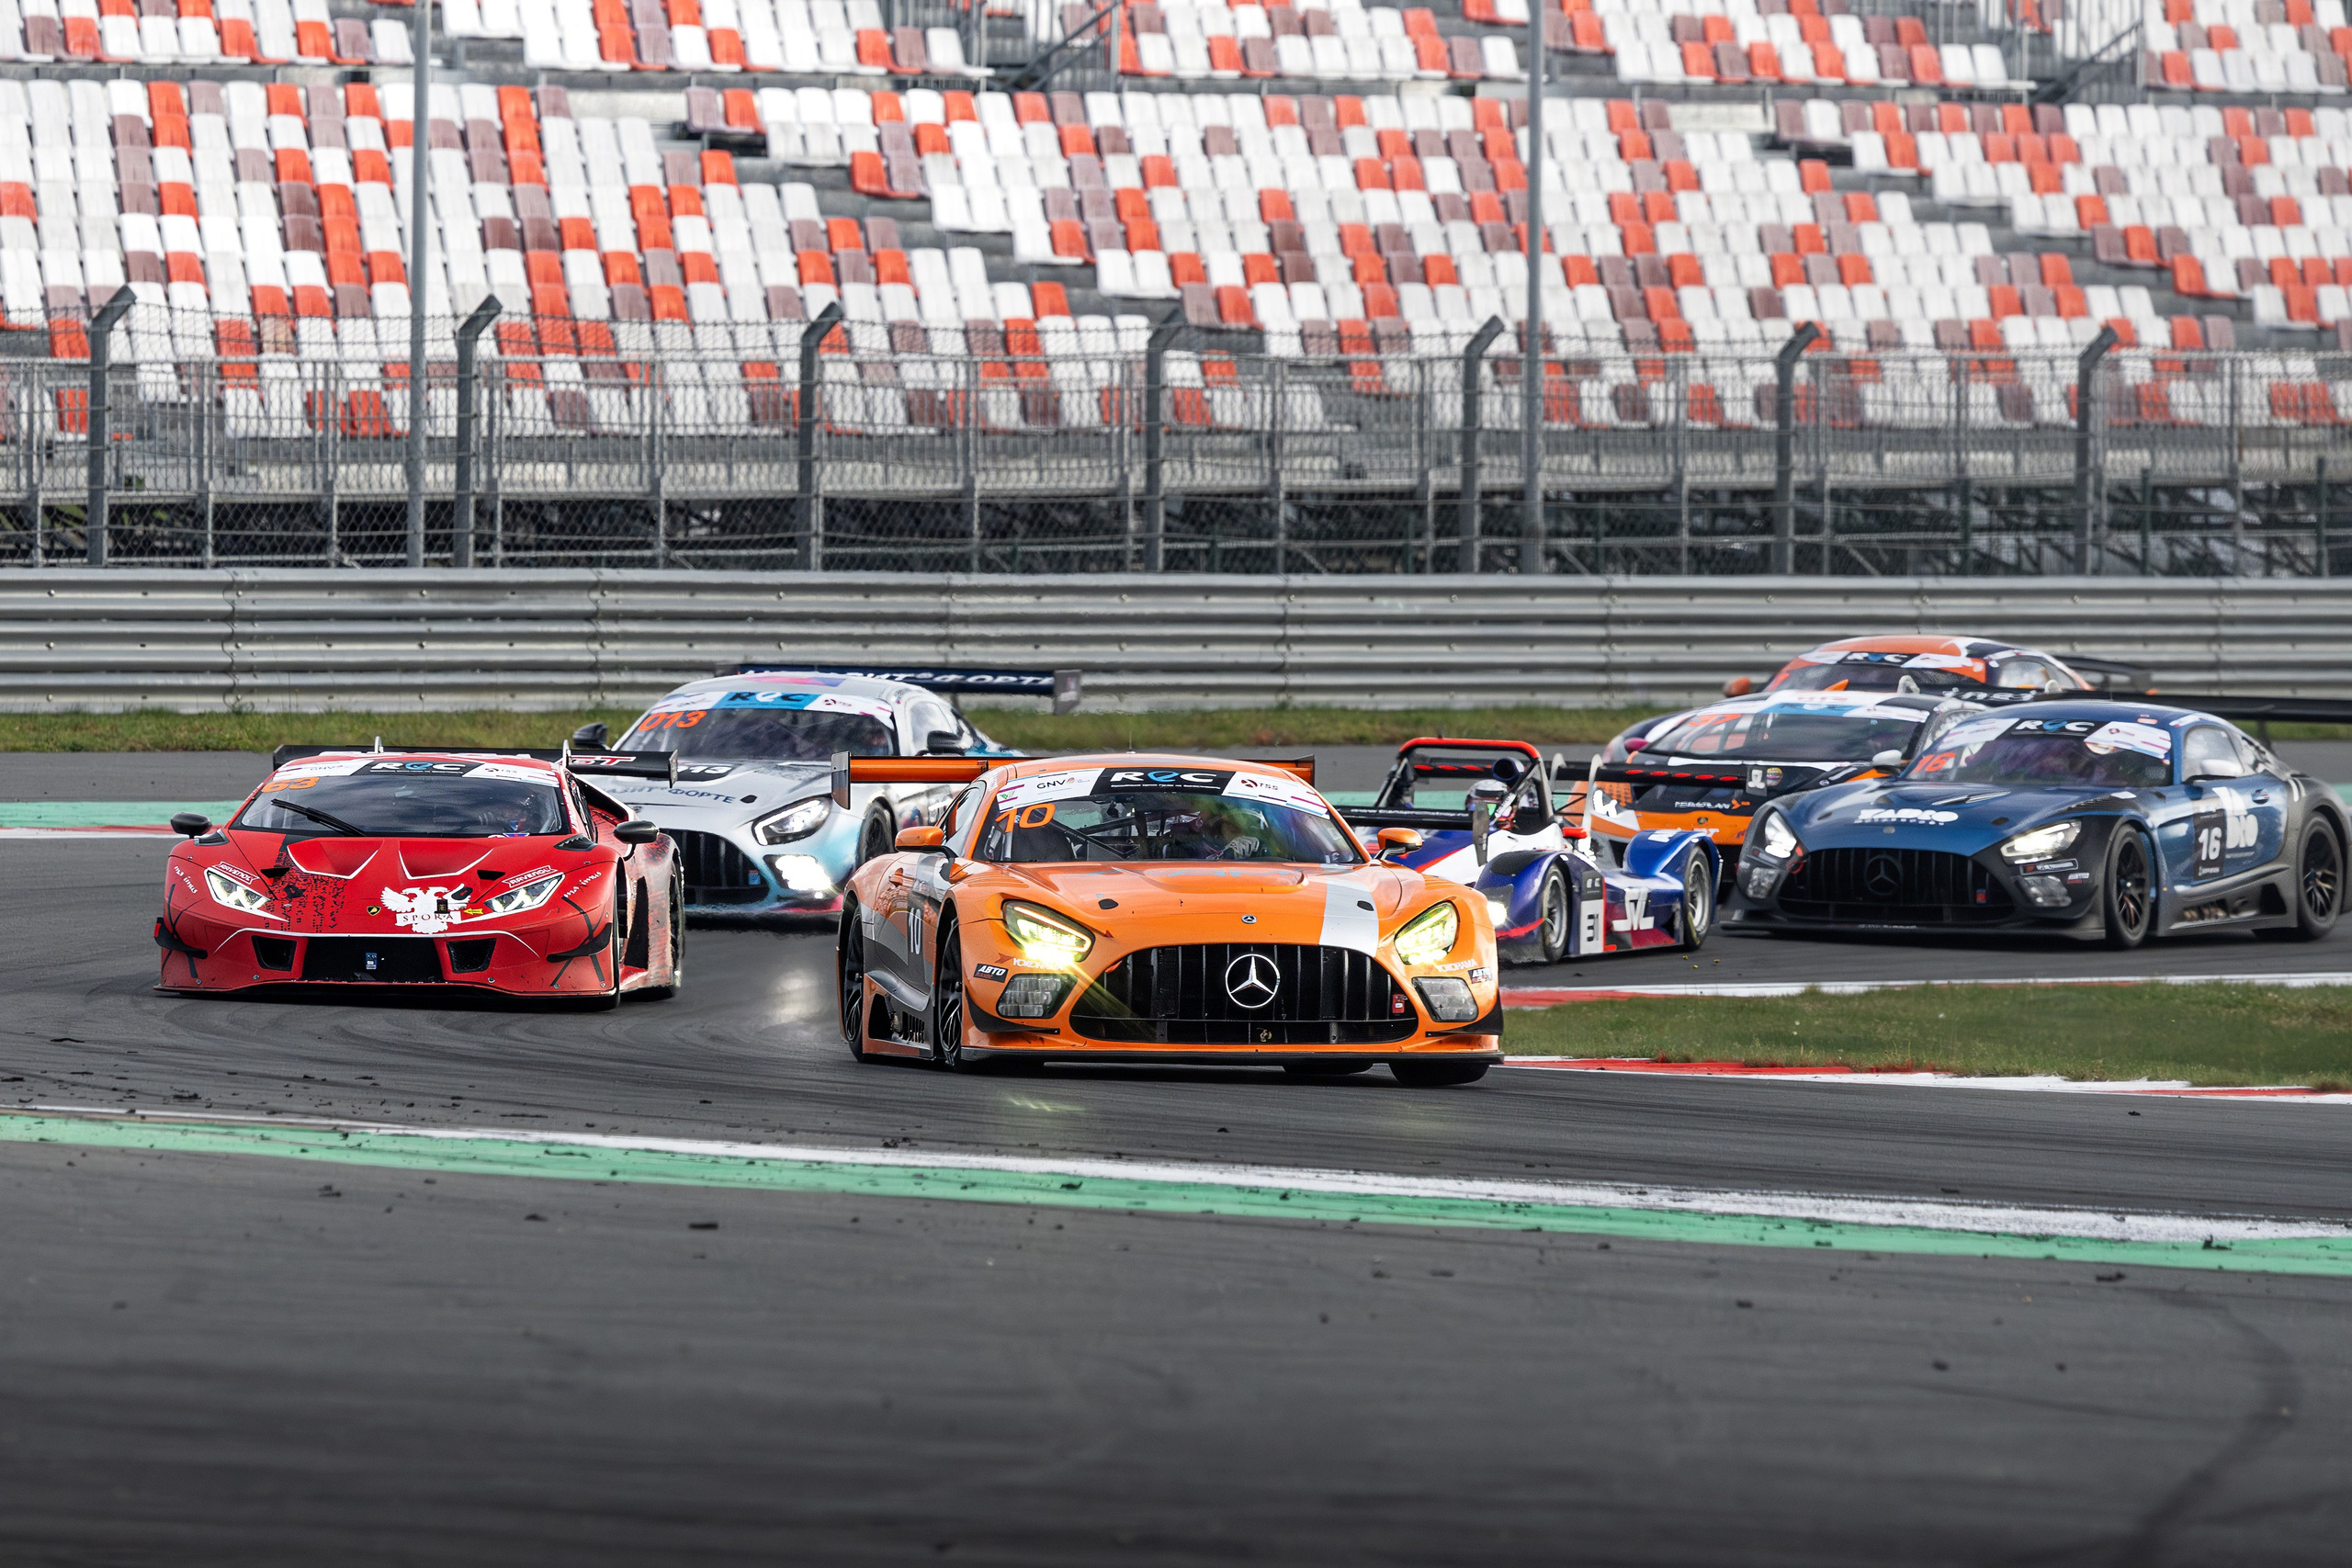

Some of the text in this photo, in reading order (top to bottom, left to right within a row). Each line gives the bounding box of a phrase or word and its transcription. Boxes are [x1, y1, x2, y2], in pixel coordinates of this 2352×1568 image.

[638, 711, 707, 731] 013
[1913, 752, 1955, 773] 16
[261, 776, 320, 793] 63
[995, 803, 1056, 833] 10
[2199, 827, 2222, 862] 16
[403, 913, 454, 922] SPORA
[908, 907, 922, 955] 10
